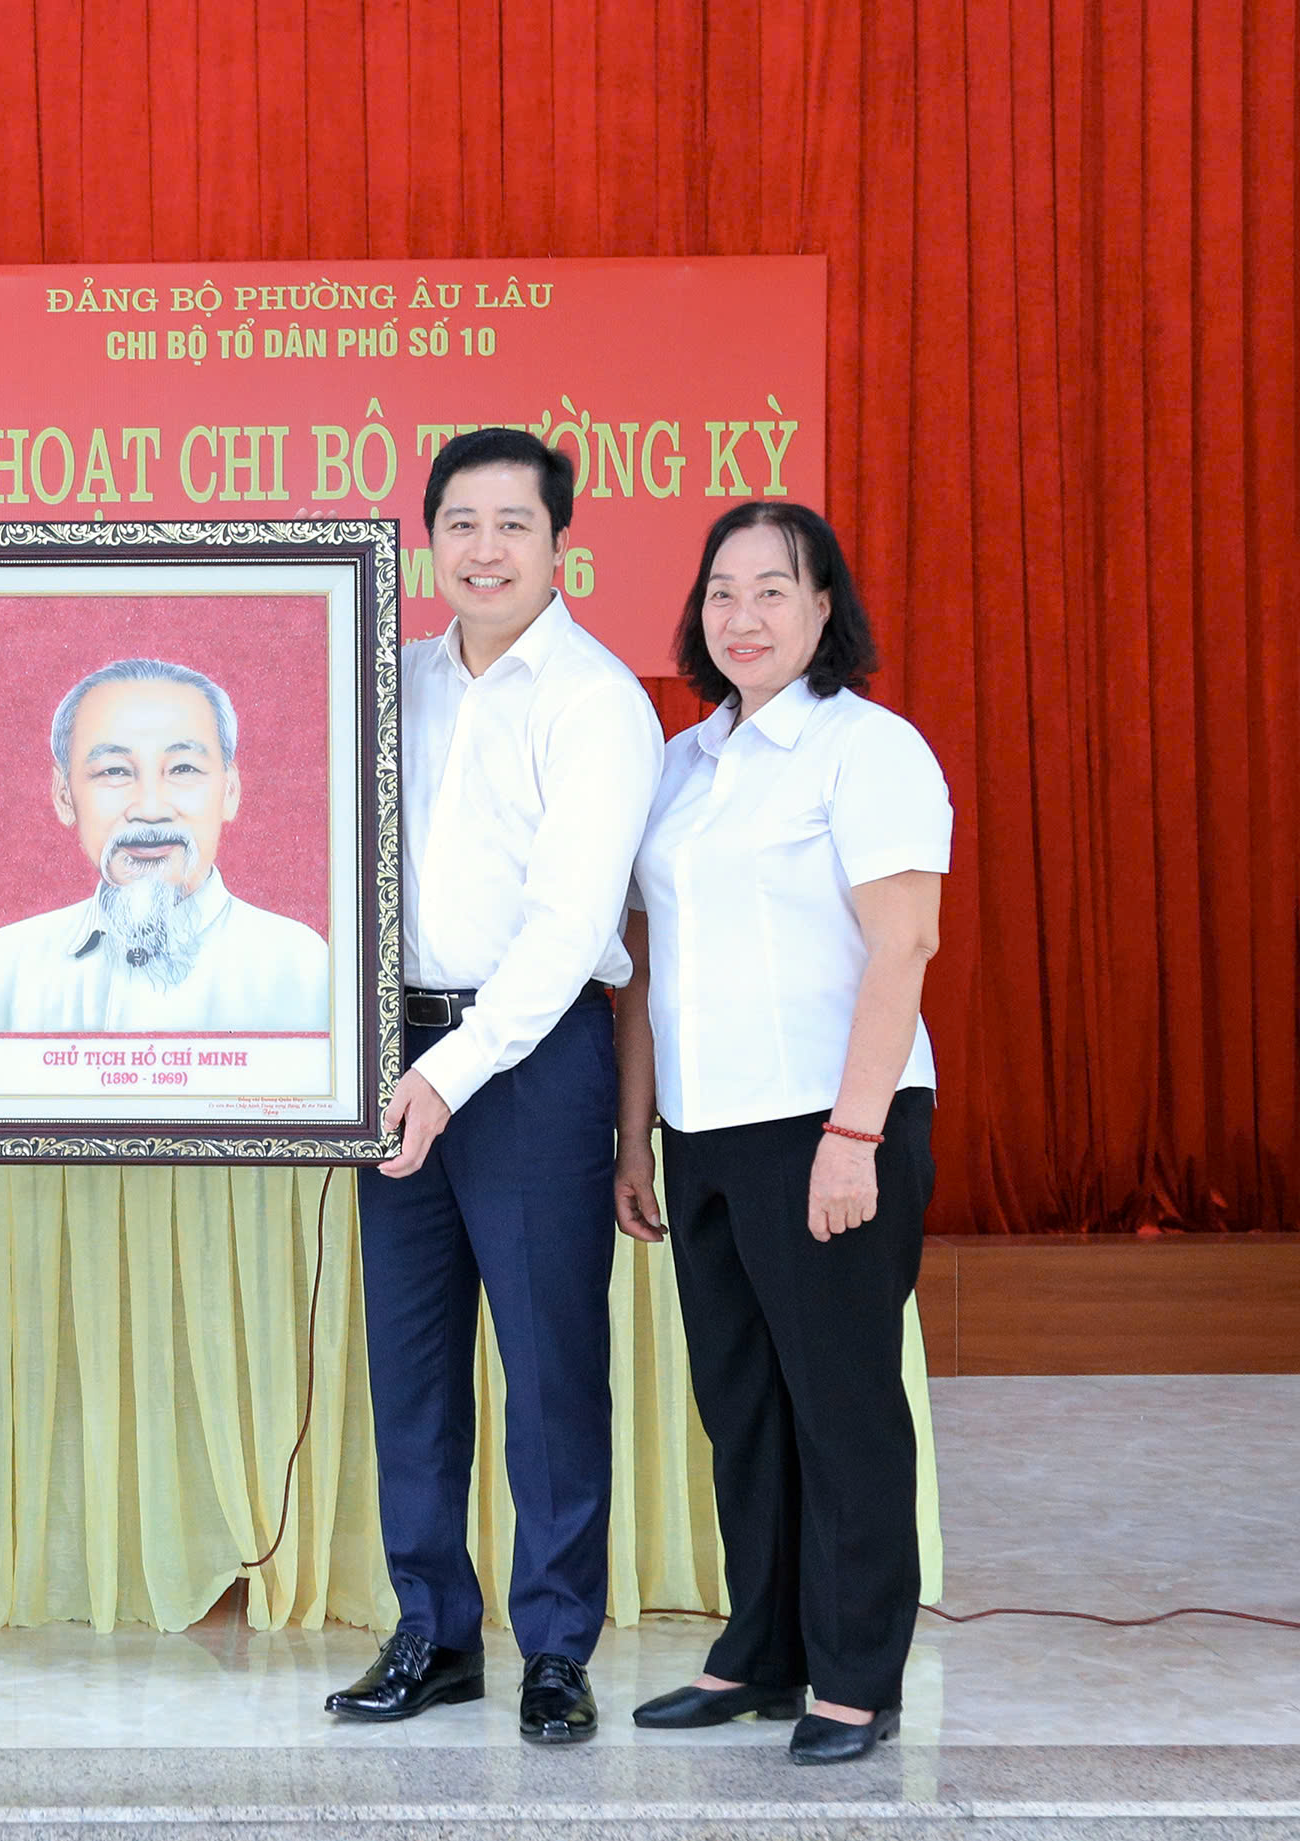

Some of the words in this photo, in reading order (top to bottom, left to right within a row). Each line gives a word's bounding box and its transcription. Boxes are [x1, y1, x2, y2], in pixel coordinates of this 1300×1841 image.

[46, 277, 159, 312] ĐẢNG
[170, 279, 222, 317] BỘ
[234, 278, 397, 311] PHƯỜNG
[408, 276, 463, 309] ÂU
[475, 276, 554, 309] LÂU
[107, 331, 157, 360] CHI
[167, 324, 207, 366] BỘ
[217, 318, 255, 359] TỔ
[264, 322, 327, 358] DÂN
[337, 317, 399, 357] PHỐ
[408, 317, 450, 357] SỐ
[460, 327, 497, 356] 10
[180, 425, 289, 503] CHI
[311, 397, 398, 520] BỘ
[704, 394, 799, 498] KỲ
[43, 1045, 79, 1066] CHỦ
[84, 1051, 126, 1070] TỊCH
[131, 1044, 157, 1066] HỒ
[161, 1047, 193, 1066] CHÍ
[198, 1051, 249, 1067] MINH
[151, 1072, 189, 1087] 1969)
